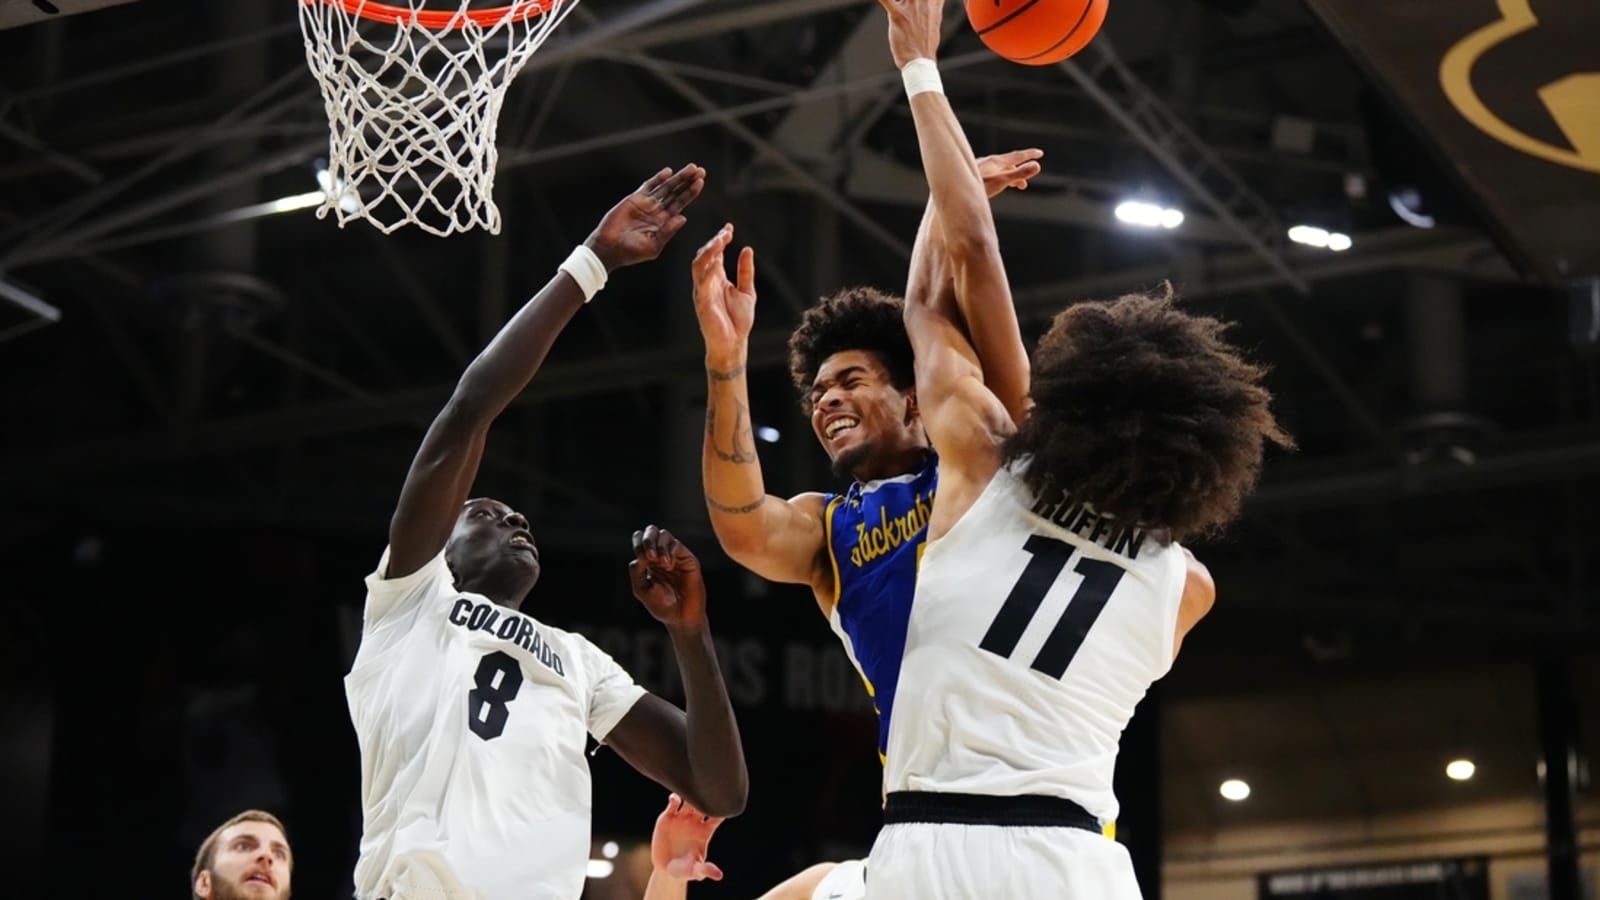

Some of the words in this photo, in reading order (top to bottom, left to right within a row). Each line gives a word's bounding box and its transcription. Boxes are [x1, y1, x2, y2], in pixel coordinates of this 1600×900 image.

[449, 598, 565, 678] COLORADO
[979, 534, 1127, 681] 11
[468, 650, 524, 741] 8
